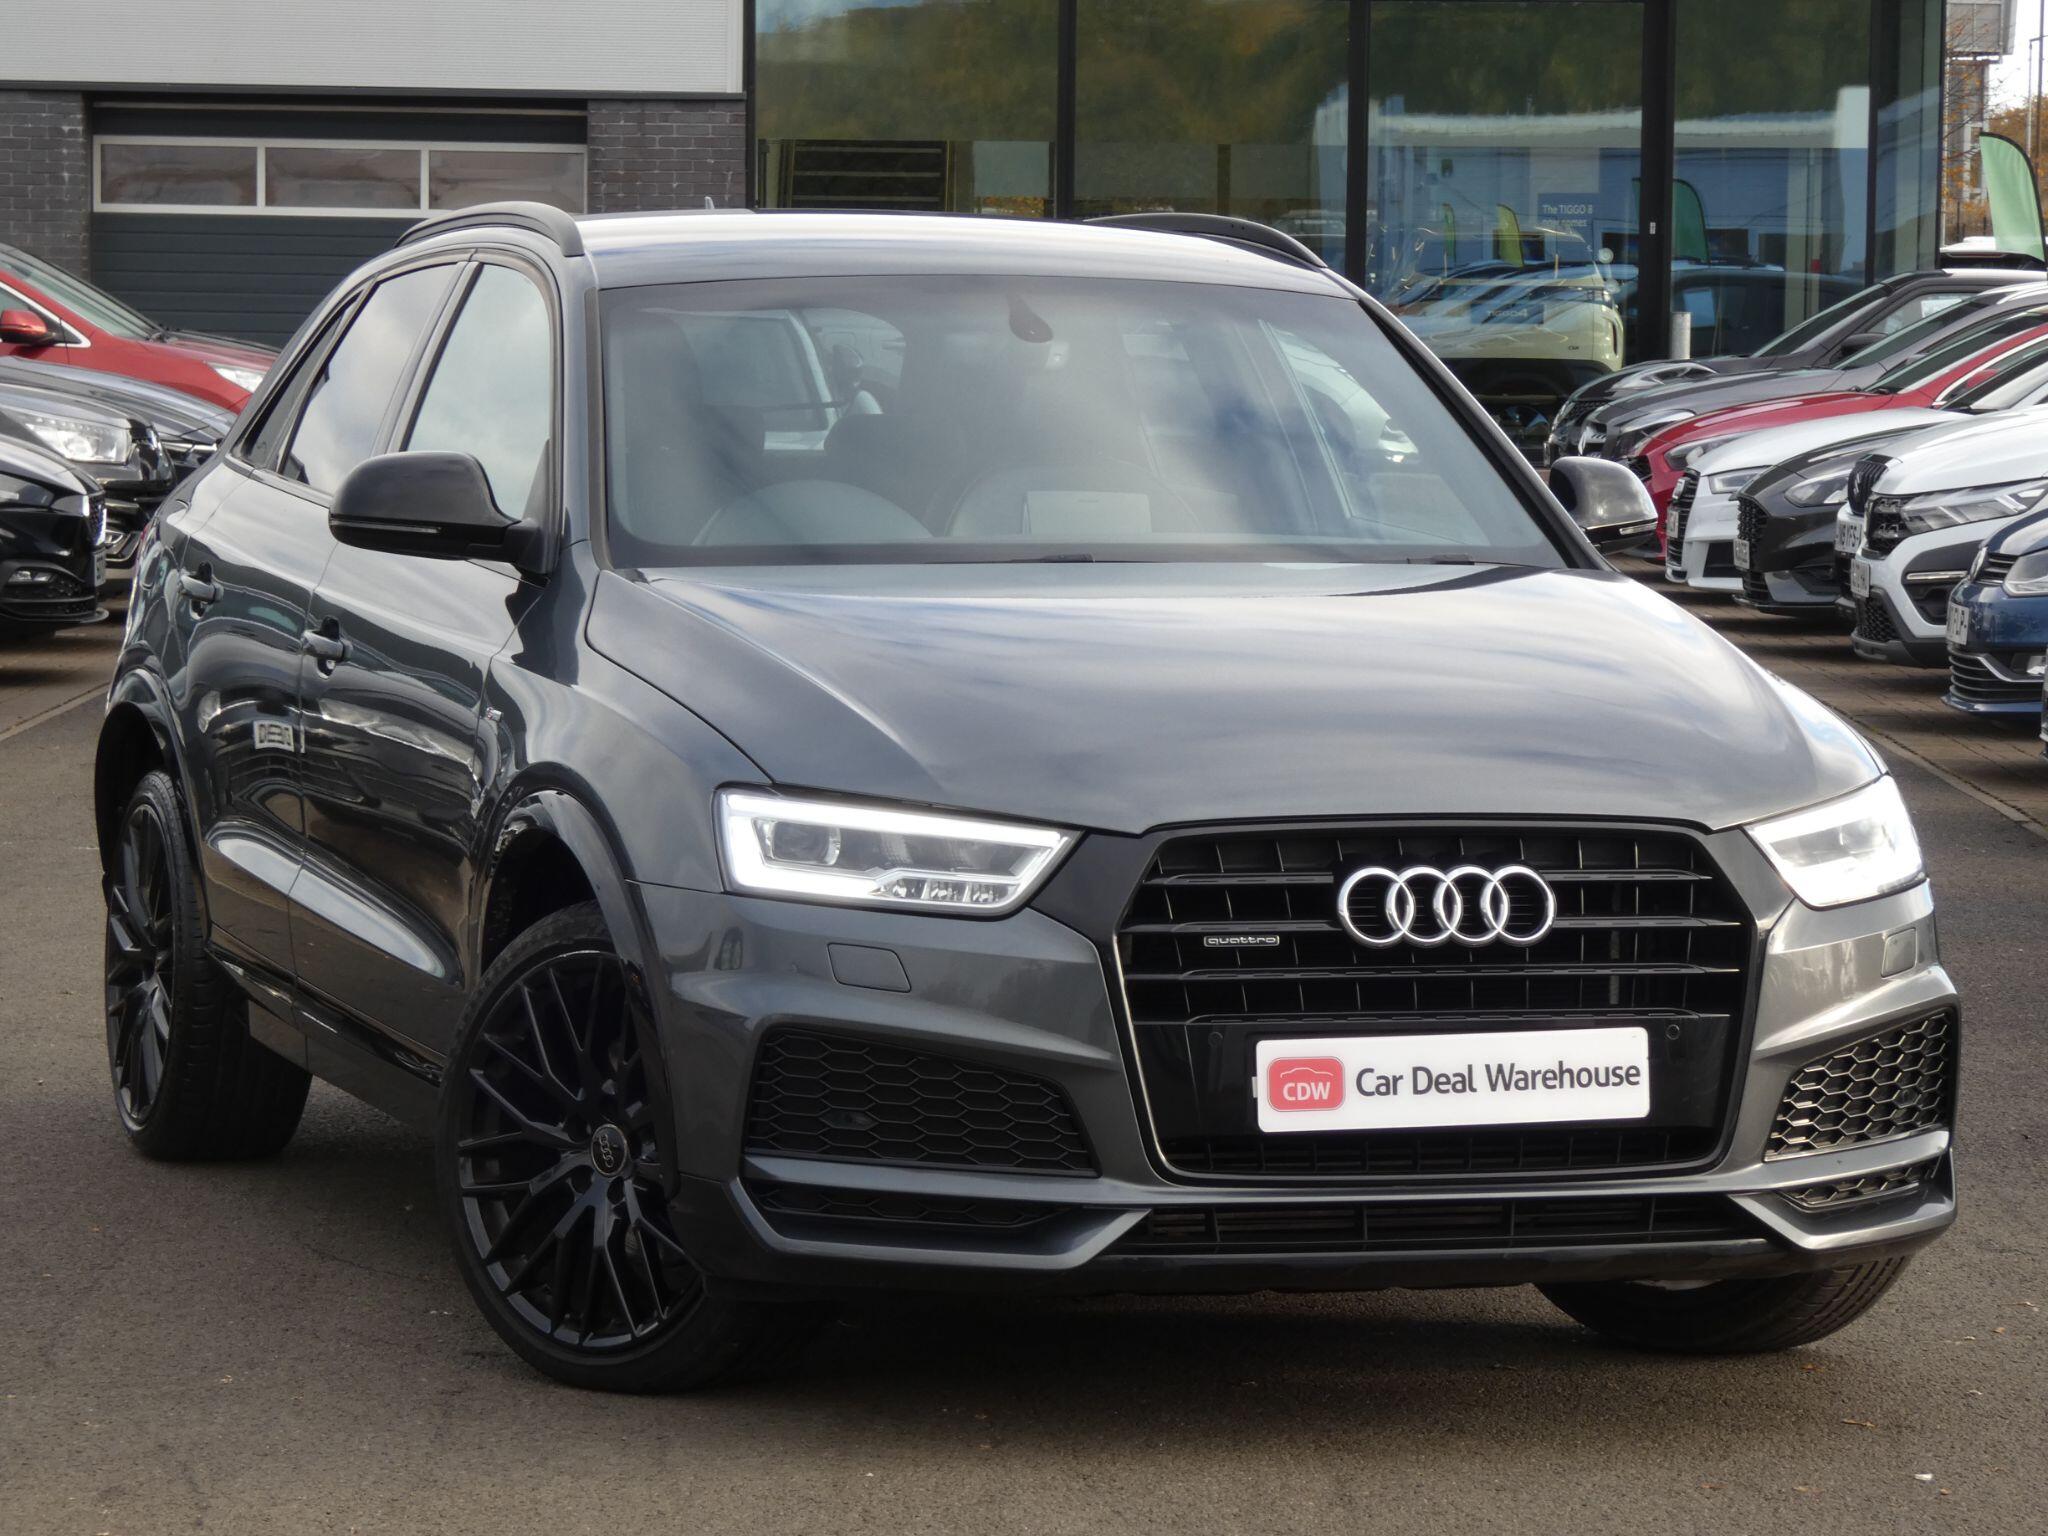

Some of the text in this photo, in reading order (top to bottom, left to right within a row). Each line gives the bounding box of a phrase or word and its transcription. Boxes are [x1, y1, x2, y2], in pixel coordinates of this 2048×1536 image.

[1542, 205, 1558, 214] The
[1559, 204, 1586, 214] TIGGO
[1207, 936, 1276, 945] quattro
[1355, 1060, 1641, 1097] Car Deal Warehouse
[1282, 1081, 1331, 1101] CDW
